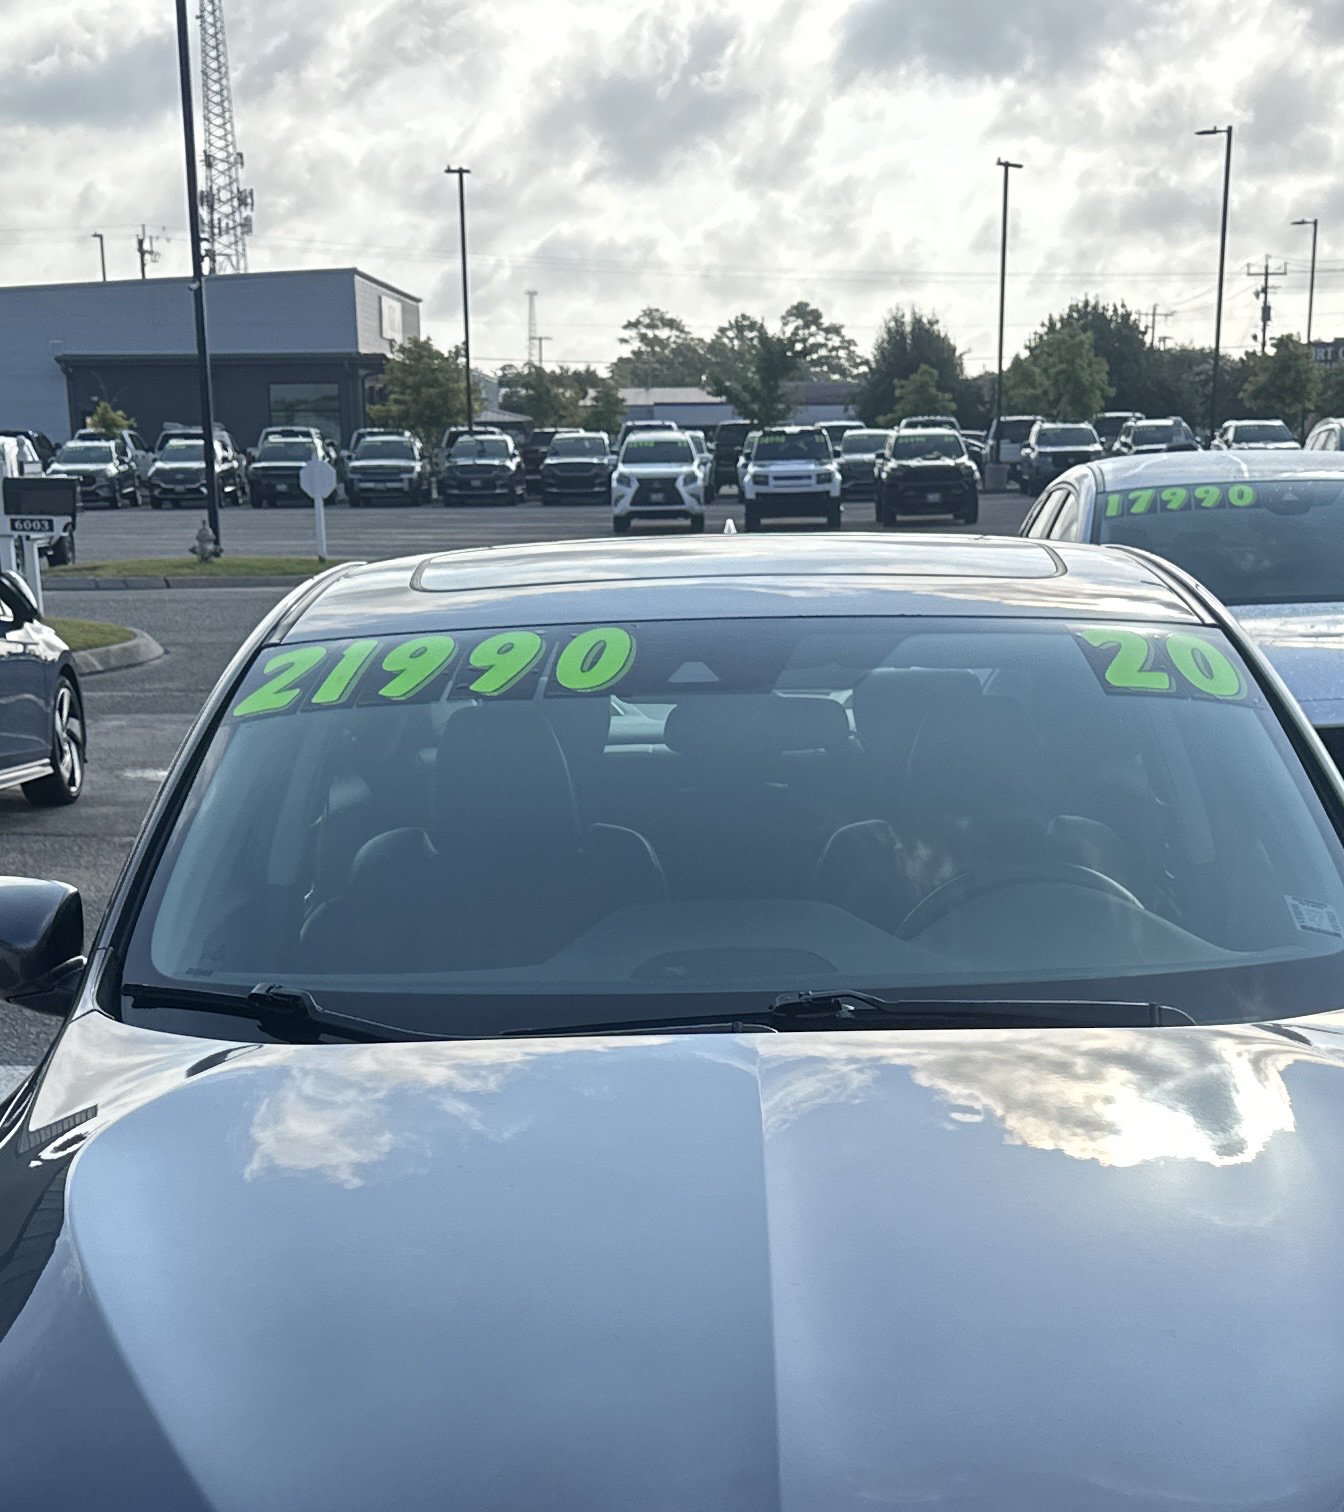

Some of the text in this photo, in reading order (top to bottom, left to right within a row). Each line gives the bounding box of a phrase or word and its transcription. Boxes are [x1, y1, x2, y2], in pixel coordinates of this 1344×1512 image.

[13, 518, 49, 531] 6003
[1106, 484, 1256, 518] 17990
[232, 626, 637, 717] 21990
[1076, 628, 1249, 699] 20
